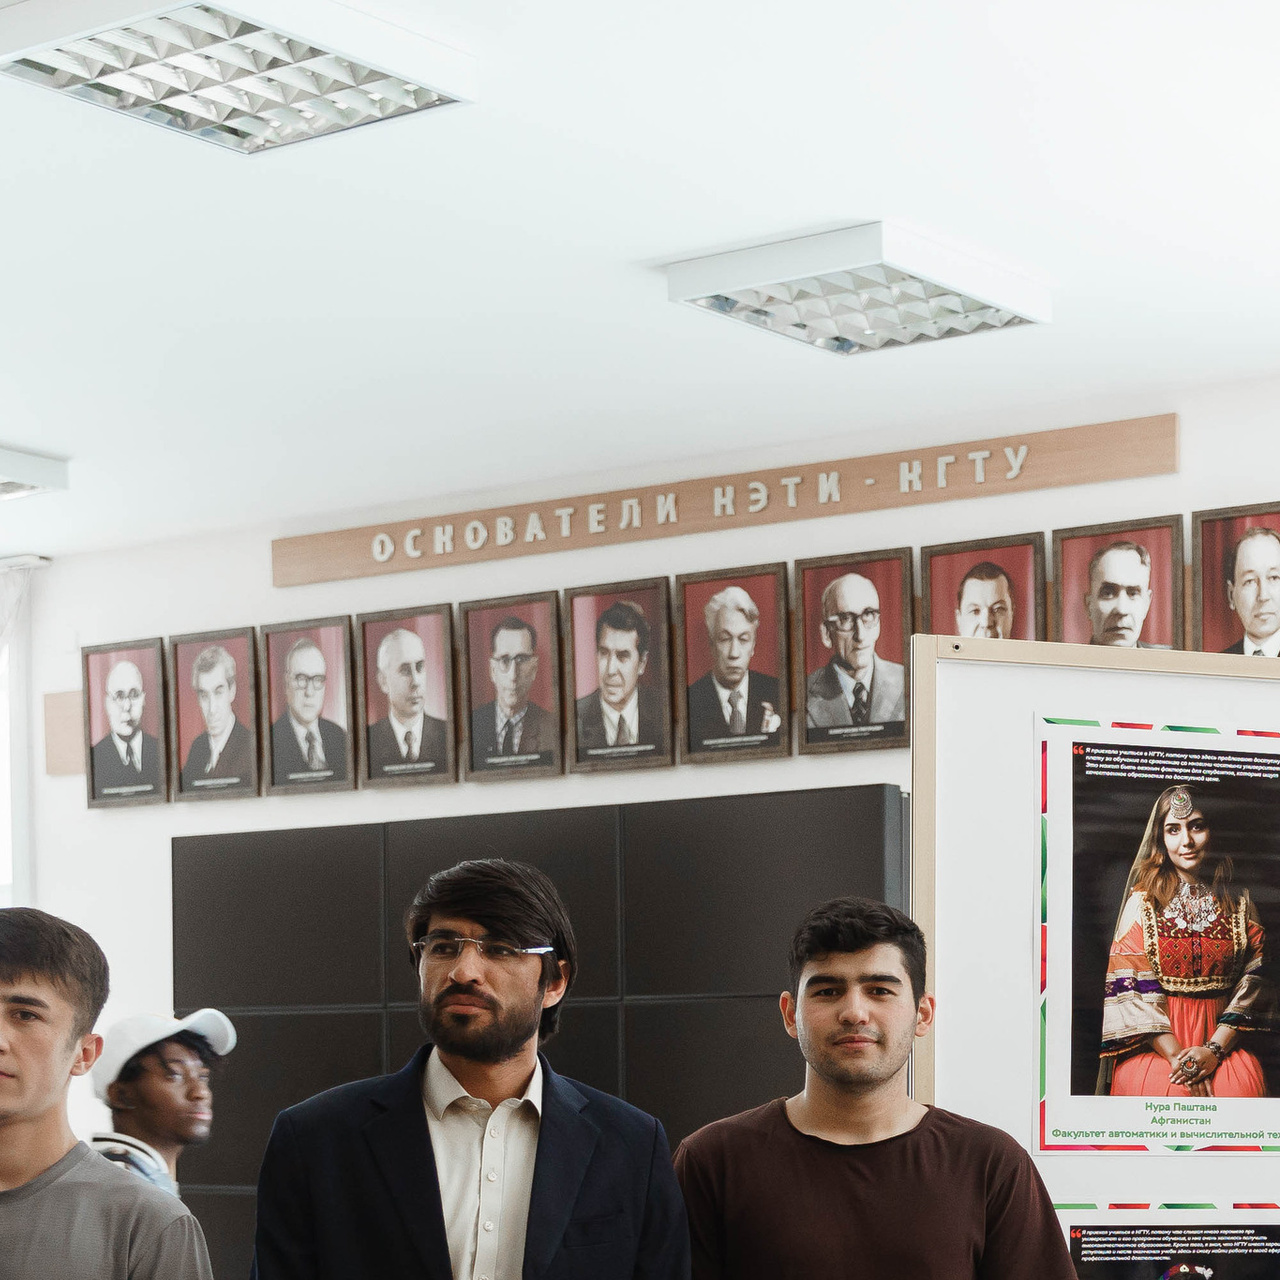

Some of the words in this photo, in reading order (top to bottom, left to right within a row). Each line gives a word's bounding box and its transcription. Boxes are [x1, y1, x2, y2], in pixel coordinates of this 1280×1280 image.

[371, 493, 678, 563] ОСНОВАТЕЛИ
[713, 471, 841, 517] НЭТИ
[899, 445, 1028, 494] НГТУ
[1145, 1102, 1170, 1112] Нура
[1173, 1102, 1217, 1112] Паштана
[1150, 1116, 1211, 1126] Афганистан
[1051, 1128, 1105, 1140] Факультет
[1108, 1130, 1168, 1138] автоматики
[1180, 1129, 1265, 1139] вычислительной
